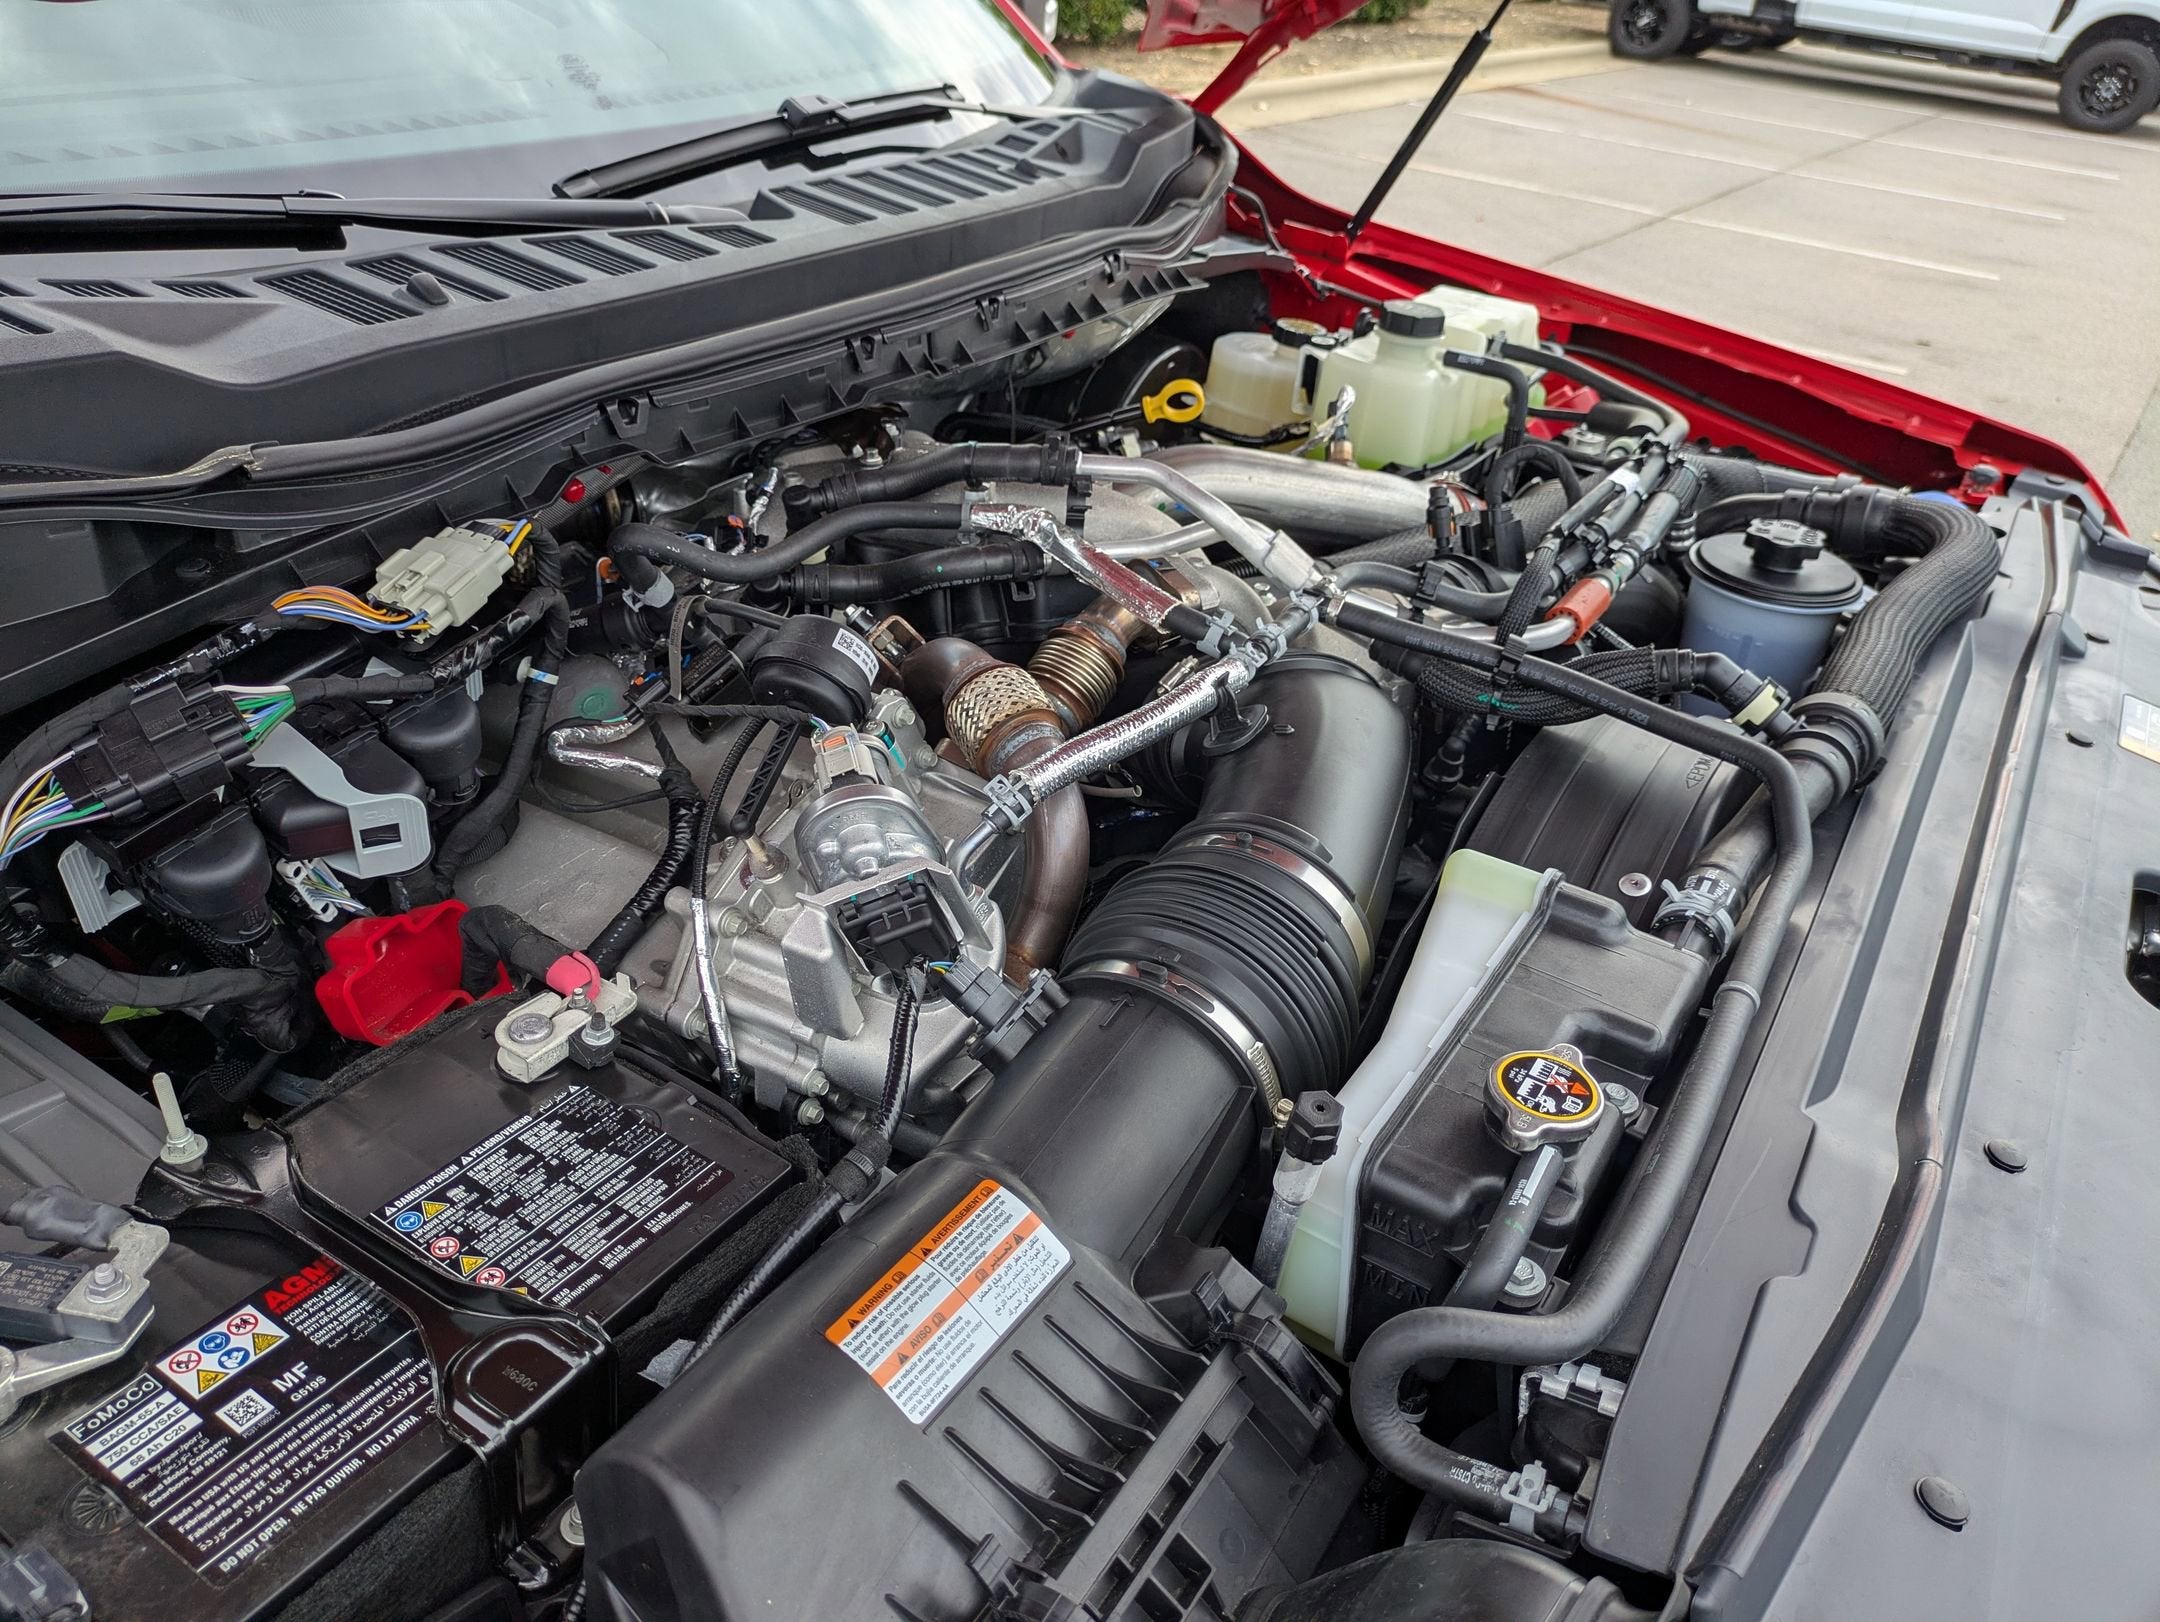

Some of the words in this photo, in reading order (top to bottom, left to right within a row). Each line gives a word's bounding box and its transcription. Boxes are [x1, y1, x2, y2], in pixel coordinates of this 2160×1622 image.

[394, 1164, 458, 1208] DANGER/POISON
[469, 1114, 532, 1157] PELIGRO/VENENO
[410, 1218, 439, 1238] EXPLOSIVE
[437, 1207, 456, 1220] GASES
[474, 1230, 499, 1249] SULFURIC
[496, 1222, 510, 1233] ACID
[643, 1218, 657, 1229] LEA
[654, 1211, 667, 1221] LAS
[650, 1199, 693, 1233] INSTRUCCIONES.
[930, 1194, 982, 1244] AVERTISSEMENT
[930, 1249, 943, 1262] Pour
[940, 1234, 958, 1252] réduire
[955, 1229, 963, 1237] le
[960, 1217, 977, 1233] risque
[973, 1211, 982, 1219] de
[979, 1192, 1001, 1214] blessures
[1369, 1201, 1439, 1256] MAX
[500, 1255, 514, 1266] KEEP
[511, 1249, 522, 1257] OUT
[526, 1238, 536, 1247] THE
[598, 1252, 614, 1265] LIRE
[611, 1244, 624, 1255] LES
[604, 1235, 647, 1269] INSTRUCTIONS.
[273, 1270, 335, 1317] TECHNOLOG
[288, 1310, 309, 1327] Lead
[307, 1299, 325, 1314] Acid
[323, 1283, 347, 1302] Batter
[551, 1287, 570, 1302] READ
[558, 1271, 603, 1307] INSTRUCTIONS.
[856, 1281, 893, 1317] WARNING
[865, 1332, 873, 1341] or
[870, 1317, 888, 1335] death:
[885, 1310, 895, 1319] Do
[893, 1303, 903, 1312] not
[900, 1295, 911, 1305] use
[908, 1281, 924, 1297] starter
[921, 1269, 936, 1284] fluids
[1363, 1262, 1431, 1307] MIN
[295, 1308, 326, 1332] Batterie
[324, 1302, 335, 1312] au
[334, 1288, 356, 1306] plom
[301, 1321, 320, 1336] ANTI
[316, 1290, 362, 1326] DÉVERSEME
[308, 1318, 339, 1342] CONTRA
[337, 1297, 369, 1322] DERRAM
[842, 1339, 852, 1348] To
[850, 1323, 869, 1342] reduce
[866, 1313, 878, 1325] risk
[875, 1308, 884, 1316] of
[881, 1289, 904, 1311] possible
[900, 1272, 920, 1292] serious
[857, 1345, 873, 1361] (such
[871, 1340, 879, 1348] as
[876, 1325, 893, 1342] ether)
[890, 1316, 902, 1328] with
[899, 1309, 909, 1319] the
[906, 1299, 920, 1312] glow
[917, 1289, 930, 1302] plug
[926, 1276, 942, 1292] starter
[887, 1378, 902, 1392] Para
[898, 1360, 919, 1380] reducir
[915, 1354, 924, 1363] el
[921, 1340, 939, 1358] riesgo
[935, 1333, 945, 1342] de
[941, 1314, 963, 1336] lesiones
[894, 1378, 915, 1400] severas
[917, 1355, 937, 1376] muerte:
[934, 1347, 944, 1357] No
[941, 1339, 952, 1350] use
[949, 1324, 966, 1341] fluidos
[962, 1318, 972, 1327] de
[908, 1324, 933, 1349] AVISO
[271, 1359, 314, 1394] MF
[70, 1376, 156, 1440] FoMoCo
[97, 1397, 166, 1449] BAGM-65-A
[105, 1443, 129, 1463] 750
[127, 1404, 185, 1448] CCA/SAE
[128, 1453, 145, 1468] 68
[144, 1440, 164, 1456] Ah
[162, 1422, 188, 1443] C20
[177, 1502, 217, 1534] Fabriqué
[213, 1492, 231, 1507] aux
[226, 1460, 271, 1495] États-Unis
[268, 1448, 289, 1465] avec
[286, 1437, 302, 1451] des
[300, 1411, 337, 1441] matériaux
[334, 1383, 375, 1415] américains
[372, 1377, 383, 1386] et
[380, 1354, 415, 1382] importés.
[230, 1498, 244, 1509] en
[240, 1487, 256, 1501] los
[253, 1476, 270, 1491] EE.
[267, 1465, 285, 1480] UU.
[283, 1454, 299, 1468] con
[296, 1425, 338, 1458] materiales
[334, 1383, 394, 1430] estadounidenses
[140, 1482, 165, 1502] Ford
[161, 1463, 191, 1486] Motor
[187, 1432, 233, 1468] Company,
[147, 1472, 193, 1508] Dearborn,
[190, 1464, 205, 1477] MI
[201, 1446, 229, 1468] 48121
[167, 1504, 194, 1526] Made
[191, 1497, 203, 1508] in
[200, 1483, 221, 1501] USA
[218, 1471, 238, 1487] with
[235, 1461, 250, 1474] US
[248, 1450, 265, 1465] and
[263, 1426, 299, 1455] imported
[295, 1399, 334, 1430] materials.
[218, 1554, 239, 1573] DO
[234, 1537, 261, 1560] NOT
[256, 1513, 291, 1543] OPEN.
[289, 1499, 309, 1517] NE
[303, 1484, 328, 1505] PAS
[323, 1454, 367, 1490] OUVRIR.
[364, 1441, 383, 1458] NO
[378, 1431, 396, 1447] LA
[391, 1410, 423, 1437] ABRA.
